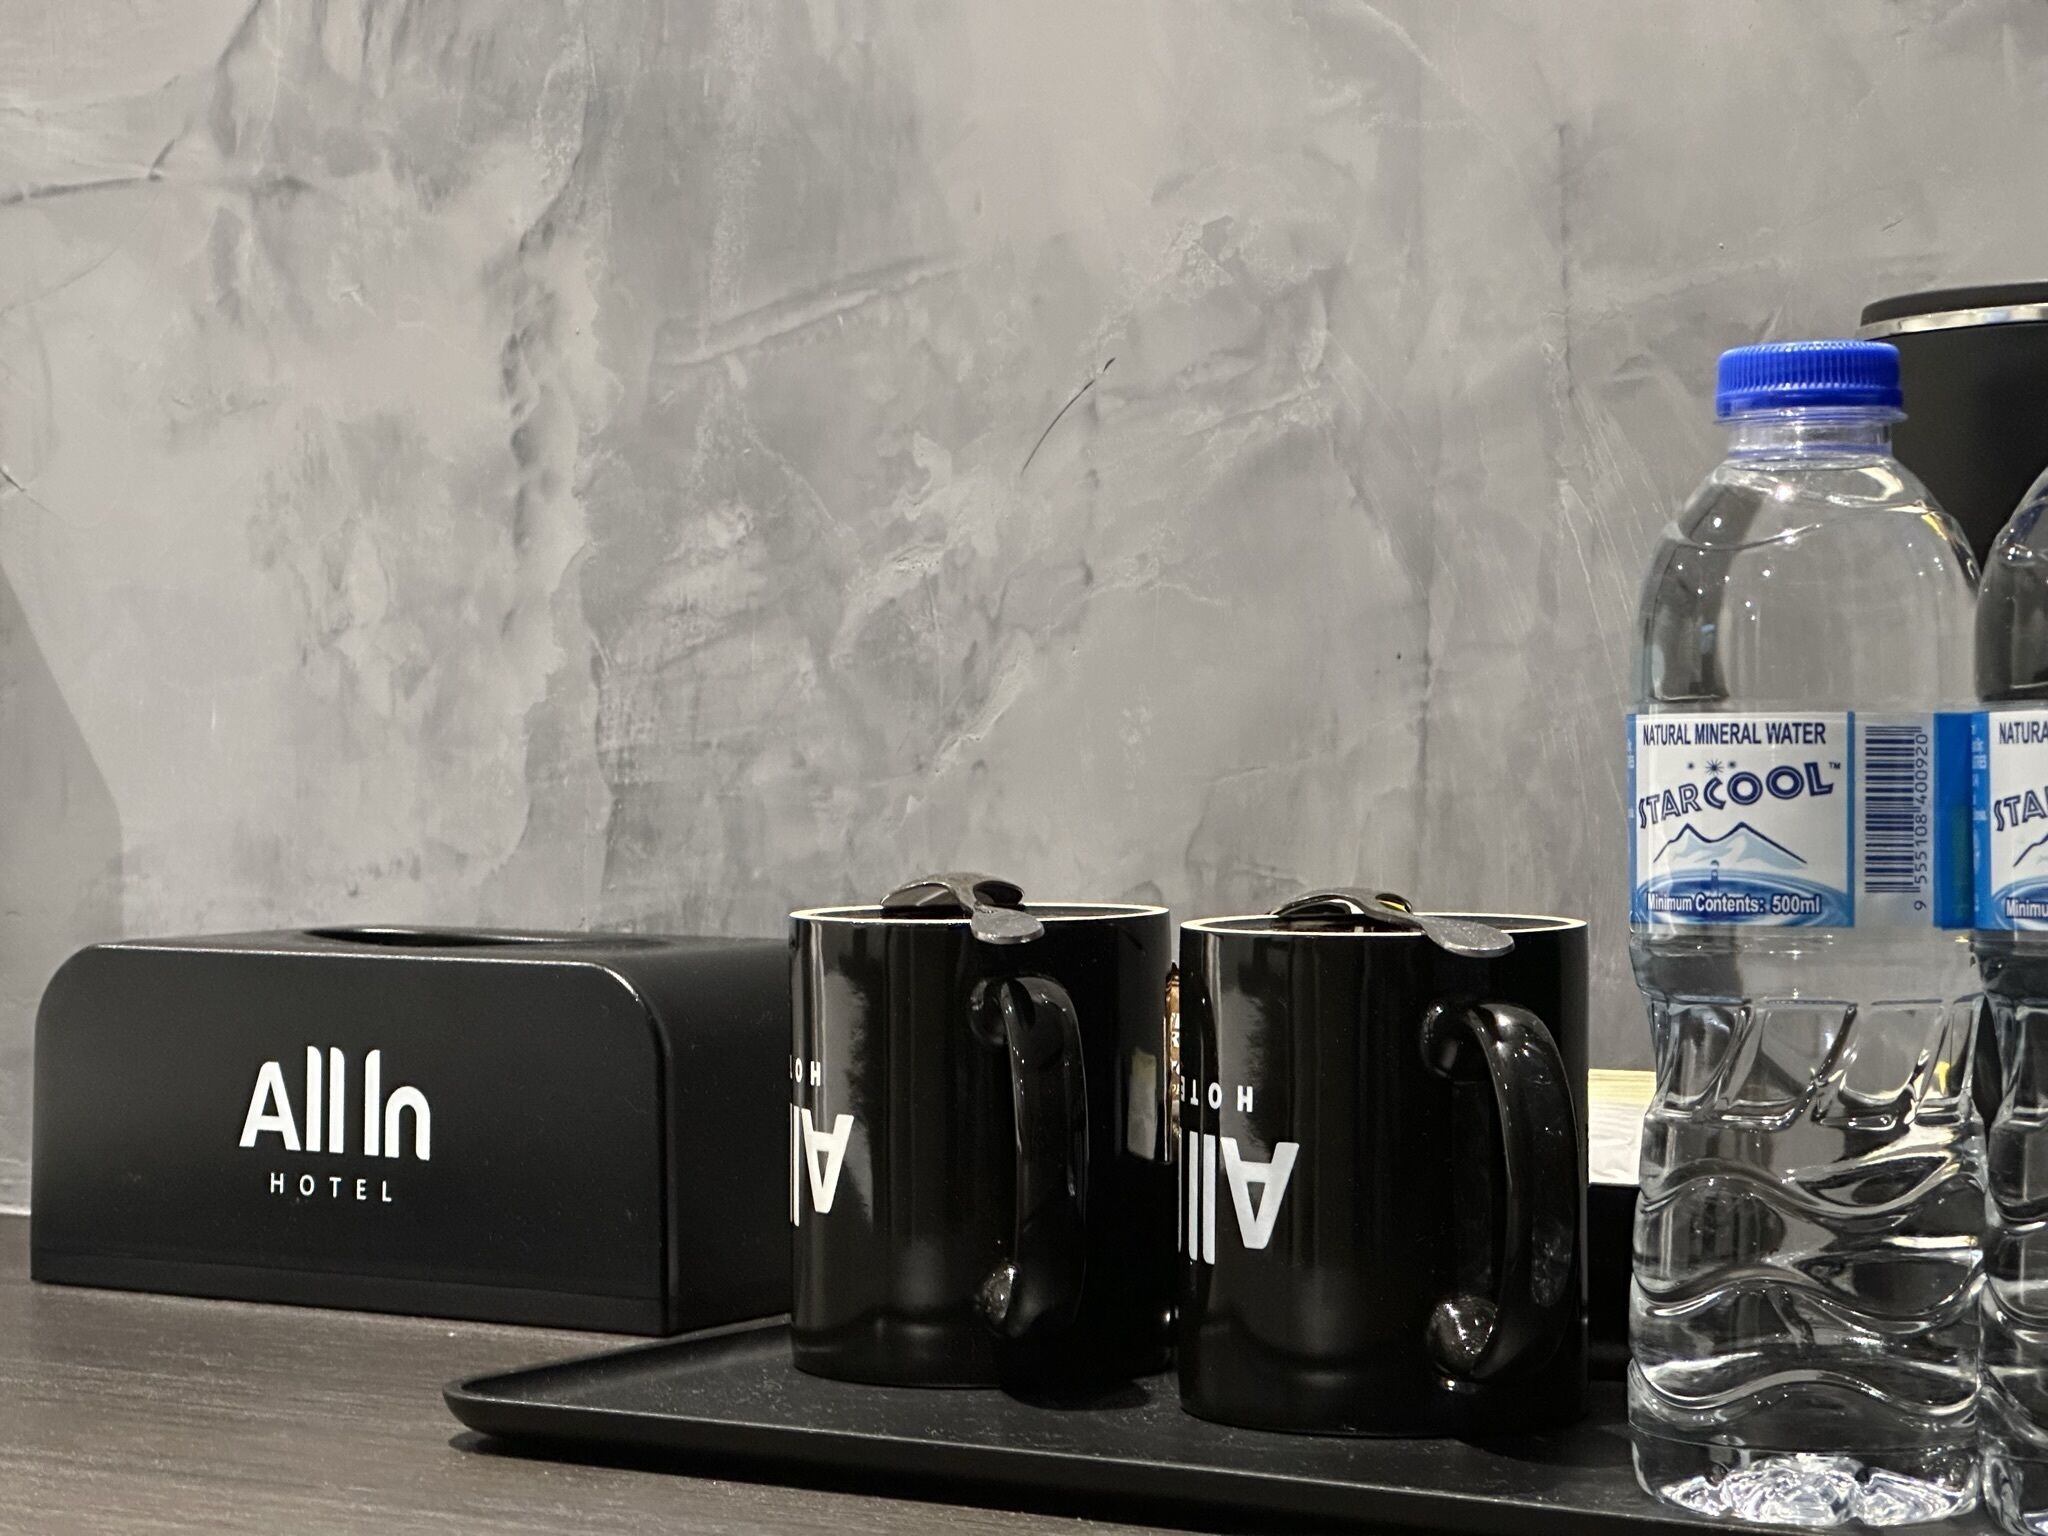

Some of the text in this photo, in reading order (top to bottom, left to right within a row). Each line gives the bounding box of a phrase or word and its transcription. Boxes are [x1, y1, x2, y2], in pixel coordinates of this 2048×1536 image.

[1643, 722, 1826, 746] NATURAL MINERAL WATER
[1638, 762, 1834, 829] STARCOOL
[1994, 786, 2048, 831] STA
[1647, 893, 1820, 913] Minimum Contents: 500ml
[239, 1045, 431, 1161] All In
[270, 1172, 392, 1202] HOTEL
